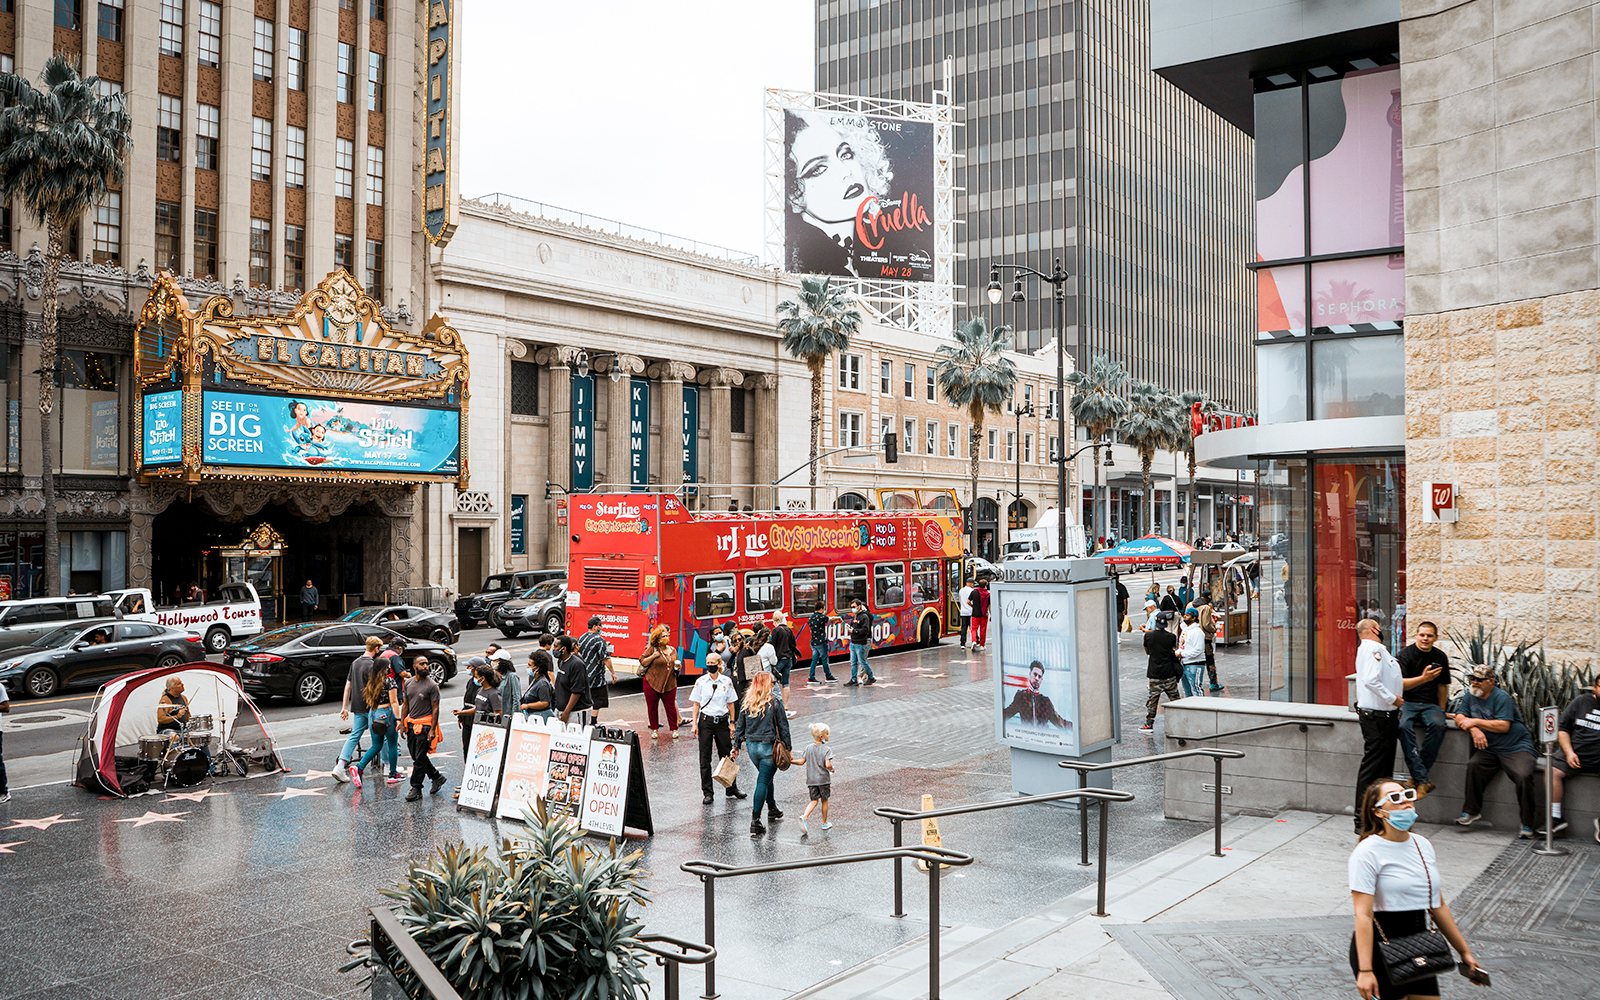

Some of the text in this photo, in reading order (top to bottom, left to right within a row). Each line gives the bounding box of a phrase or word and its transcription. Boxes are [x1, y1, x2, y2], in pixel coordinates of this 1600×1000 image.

[830, 117, 902, 132] EMMA STONE
[855, 190, 932, 250] Cruella
[860, 255, 889, 263] THEATERS
[880, 265, 899, 278] MAY
[901, 267, 912, 277] 28
[1317, 298, 1399, 316] SEPHORA
[257, 337, 424, 376] EL CAPITAN
[150, 400, 177, 410] BIG SCREEN
[211, 400, 246, 412] SEE IT
[209, 411, 262, 438] BIG
[574, 388, 586, 475] JIMMY
[682, 401, 691, 462] LIVE
[631, 387, 642, 484] KIMMEL
[207, 438, 263, 453] SCREEN
[364, 450, 382, 459] MAY
[383, 452, 391, 460] 17
[595, 501, 641, 520] StarLine
[585, 518, 642, 535] CitySightseeing
[875, 522, 896, 534] Hop On
[769, 523, 861, 552] CitySightseeing
[875, 535, 897, 547] Hop Off
[999, 568, 1071, 581] DIRECTORY
[157, 606, 256, 628] Hollywood Tours
[1005, 599, 1059, 626] Only one
[825, 621, 891, 642] OLLOD
[519, 742, 541, 753] NOW
[515, 752, 542, 765] OPEN!
[551, 751, 586, 766] NOW OPEN
[470, 763, 494, 778] NOW
[597, 769, 619, 779] WABO
[598, 762, 620, 772] CABO
[467, 778, 491, 794] OPEN
[592, 782, 621, 798] NOW
[589, 799, 619, 817] OPEN
[588, 820, 615, 832] 4TH LEVEL
